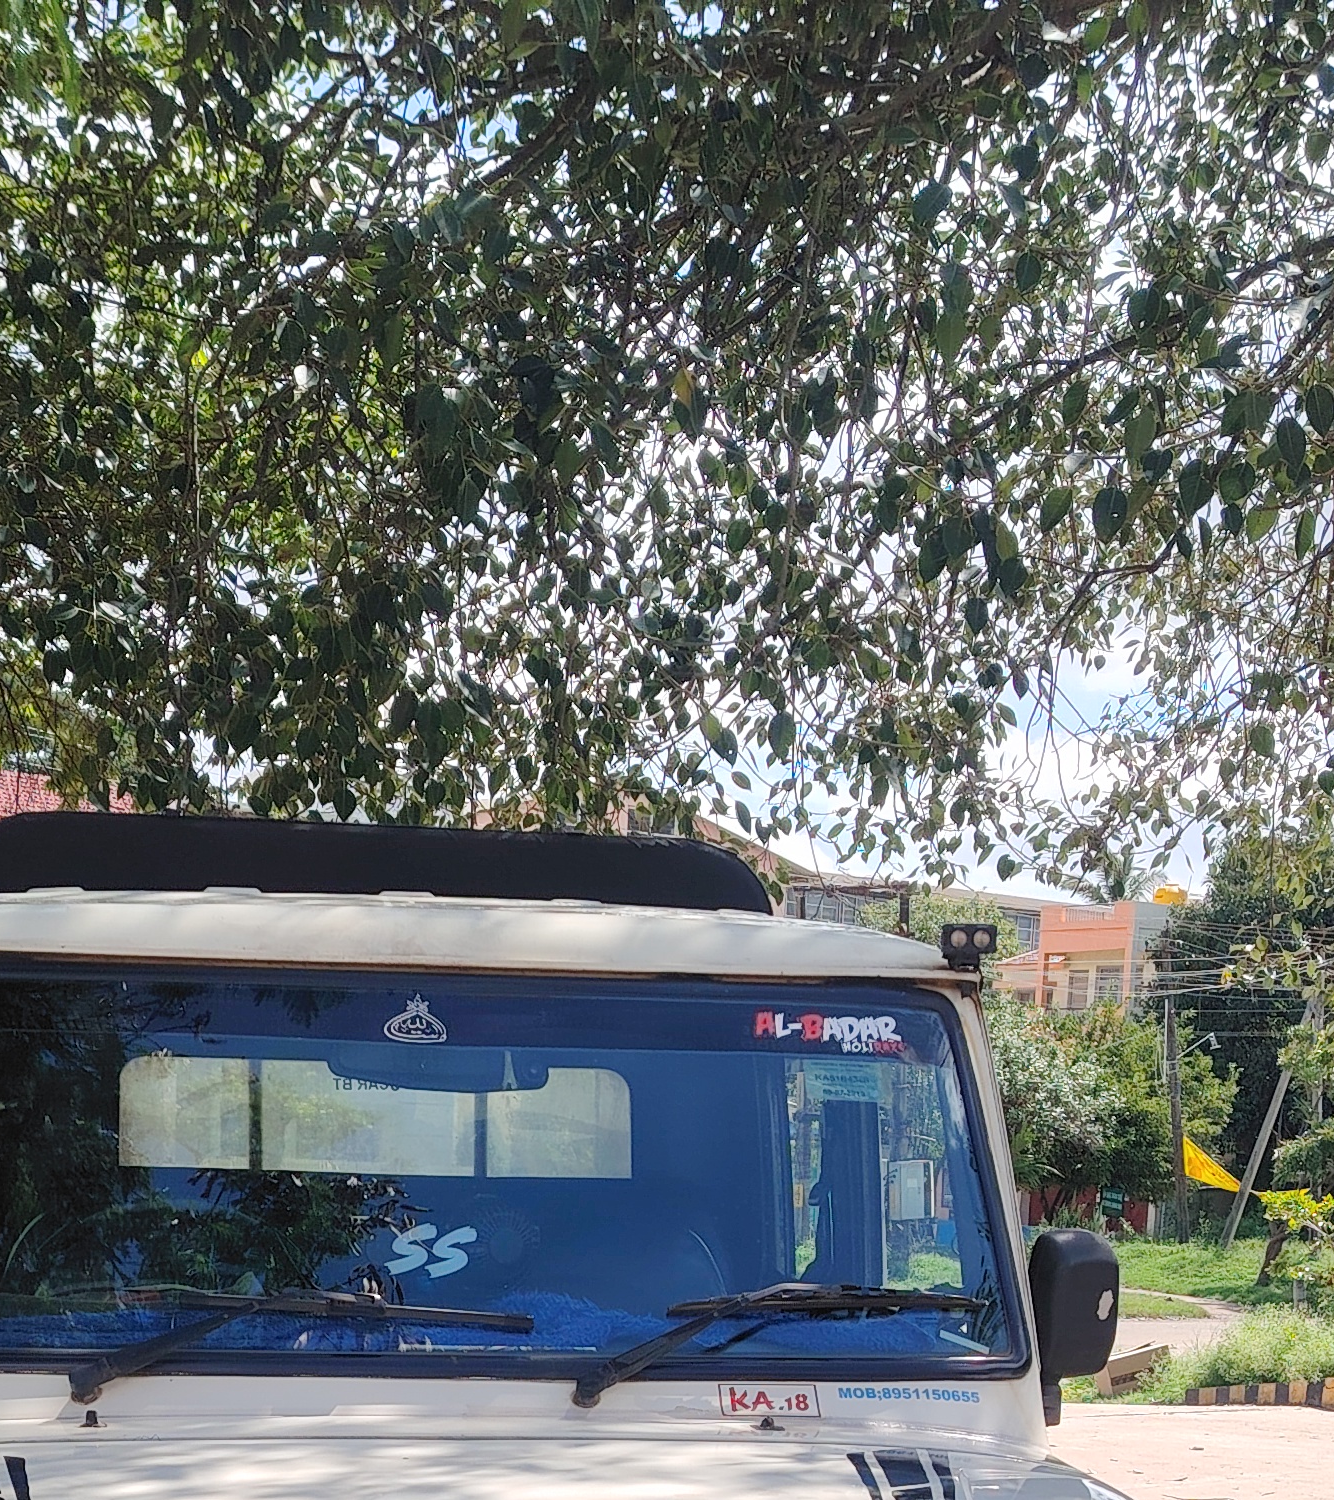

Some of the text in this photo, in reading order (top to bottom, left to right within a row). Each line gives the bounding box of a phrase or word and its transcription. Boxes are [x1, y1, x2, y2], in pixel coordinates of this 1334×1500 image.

[754, 1009, 902, 1043] AL-BADAR
[384, 1222, 478, 1279] SS
[837, 1387, 981, 1404] MOB;8951150655
